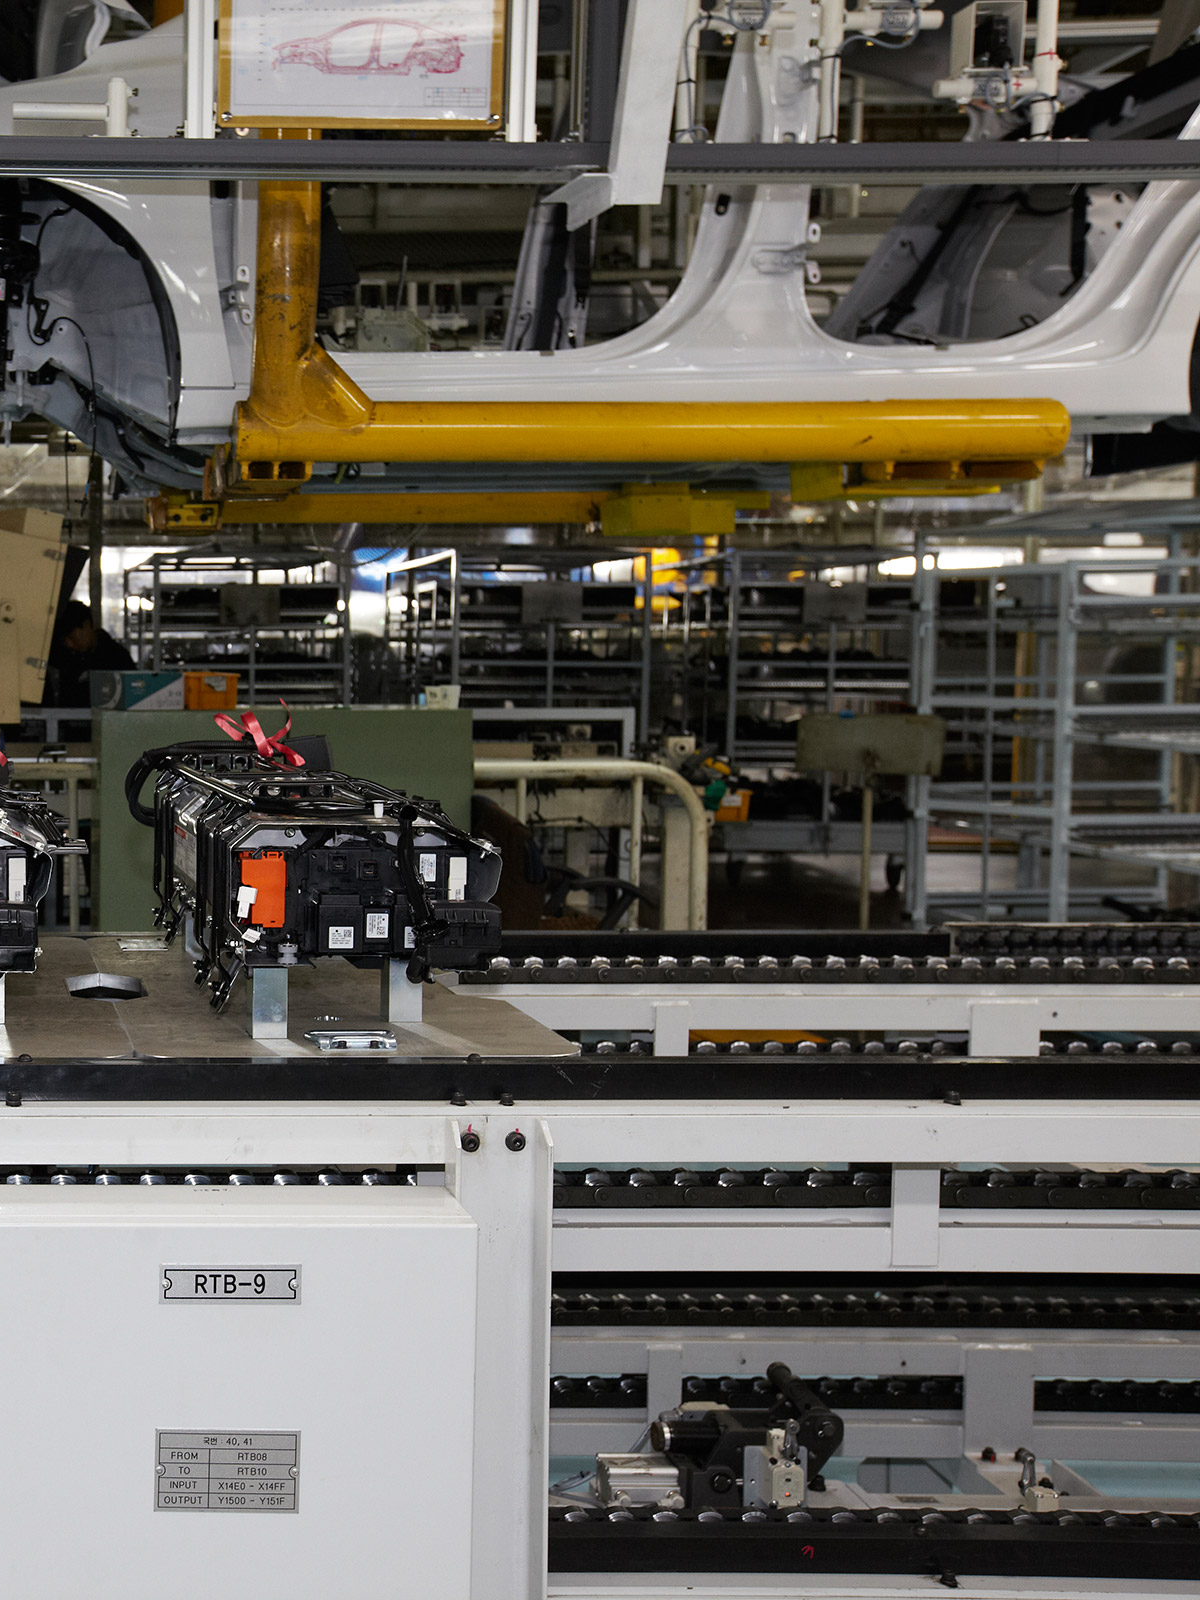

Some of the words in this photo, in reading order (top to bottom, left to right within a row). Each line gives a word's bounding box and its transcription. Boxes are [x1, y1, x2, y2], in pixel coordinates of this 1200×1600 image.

[194, 1273, 266, 1294] RTB-9
[243, 1437, 253, 1446] 41
[170, 1451, 199, 1460] FROM
[237, 1452, 268, 1461] RTB08
[178, 1466, 191, 1475] TO
[237, 1467, 268, 1476] RTB10
[169, 1480, 198, 1490] INPUT
[218, 1481, 246, 1491] X14E0
[258, 1482, 286, 1491] X14FF
[163, 1495, 203, 1505] OUTPUT
[218, 1496, 246, 1505] Y1500
[259, 1496, 286, 1506] Y151F
